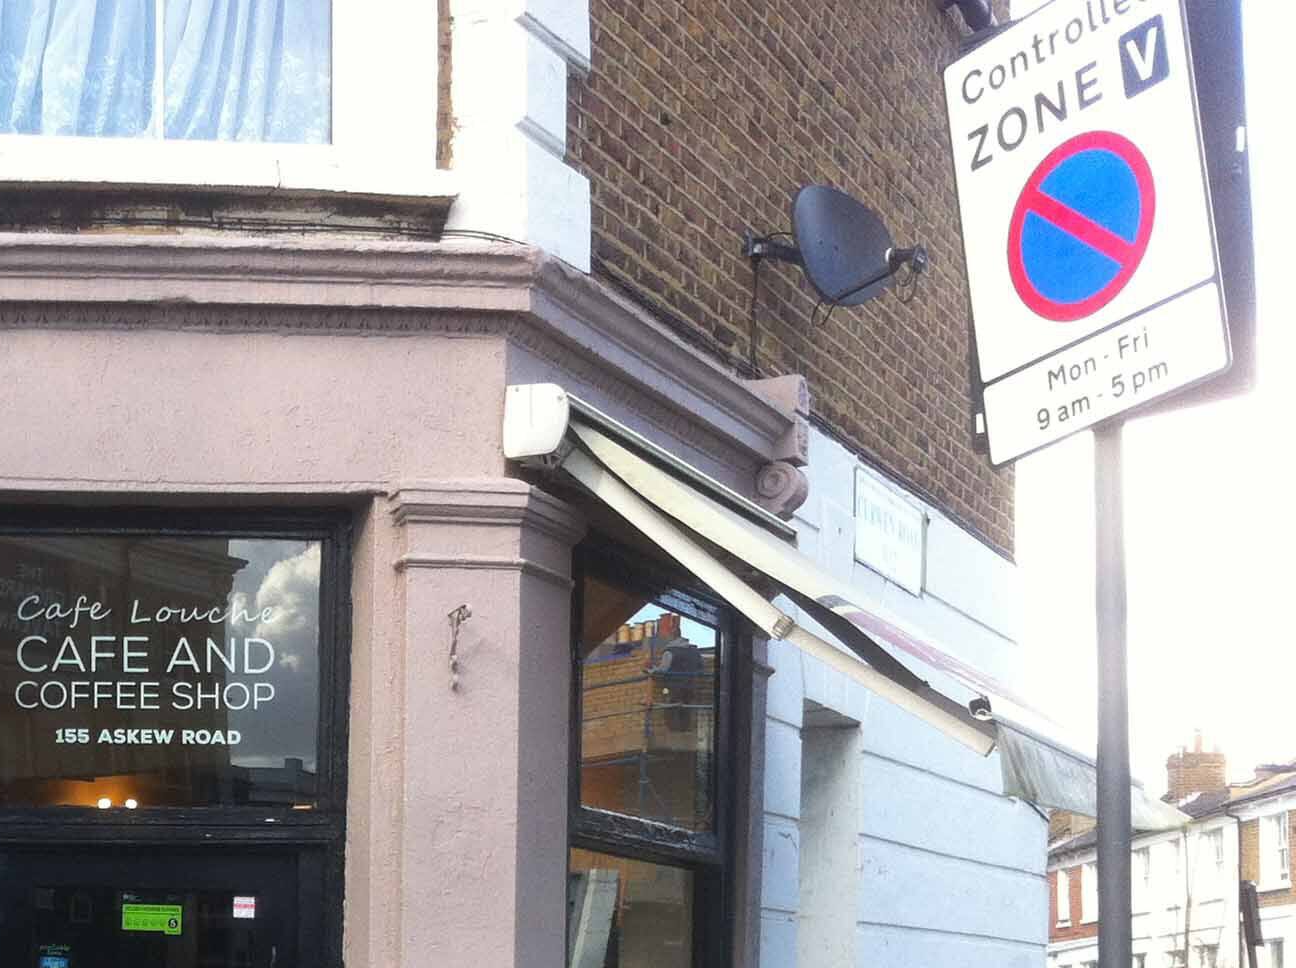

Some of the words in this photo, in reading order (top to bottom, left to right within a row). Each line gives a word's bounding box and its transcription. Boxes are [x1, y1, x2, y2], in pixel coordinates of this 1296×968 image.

[961, 0, 1148, 104] Controlle
[967, 61, 1103, 171] ZONE
[1125, 26, 1159, 81] V
[1047, 351, 1097, 391] Mon
[1117, 327, 1149, 360] Fri
[17, 595, 112, 629] Cafe
[130, 598, 276, 625] Louche
[15, 635, 150, 674] CAFE
[166, 636, 275, 675] AND
[15, 681, 161, 710] COFFEE
[171, 681, 275, 711] SHOP
[55, 729, 90, 745] 155
[97, 729, 175, 745] ASKEW
[182, 729, 242, 745] ROAD
